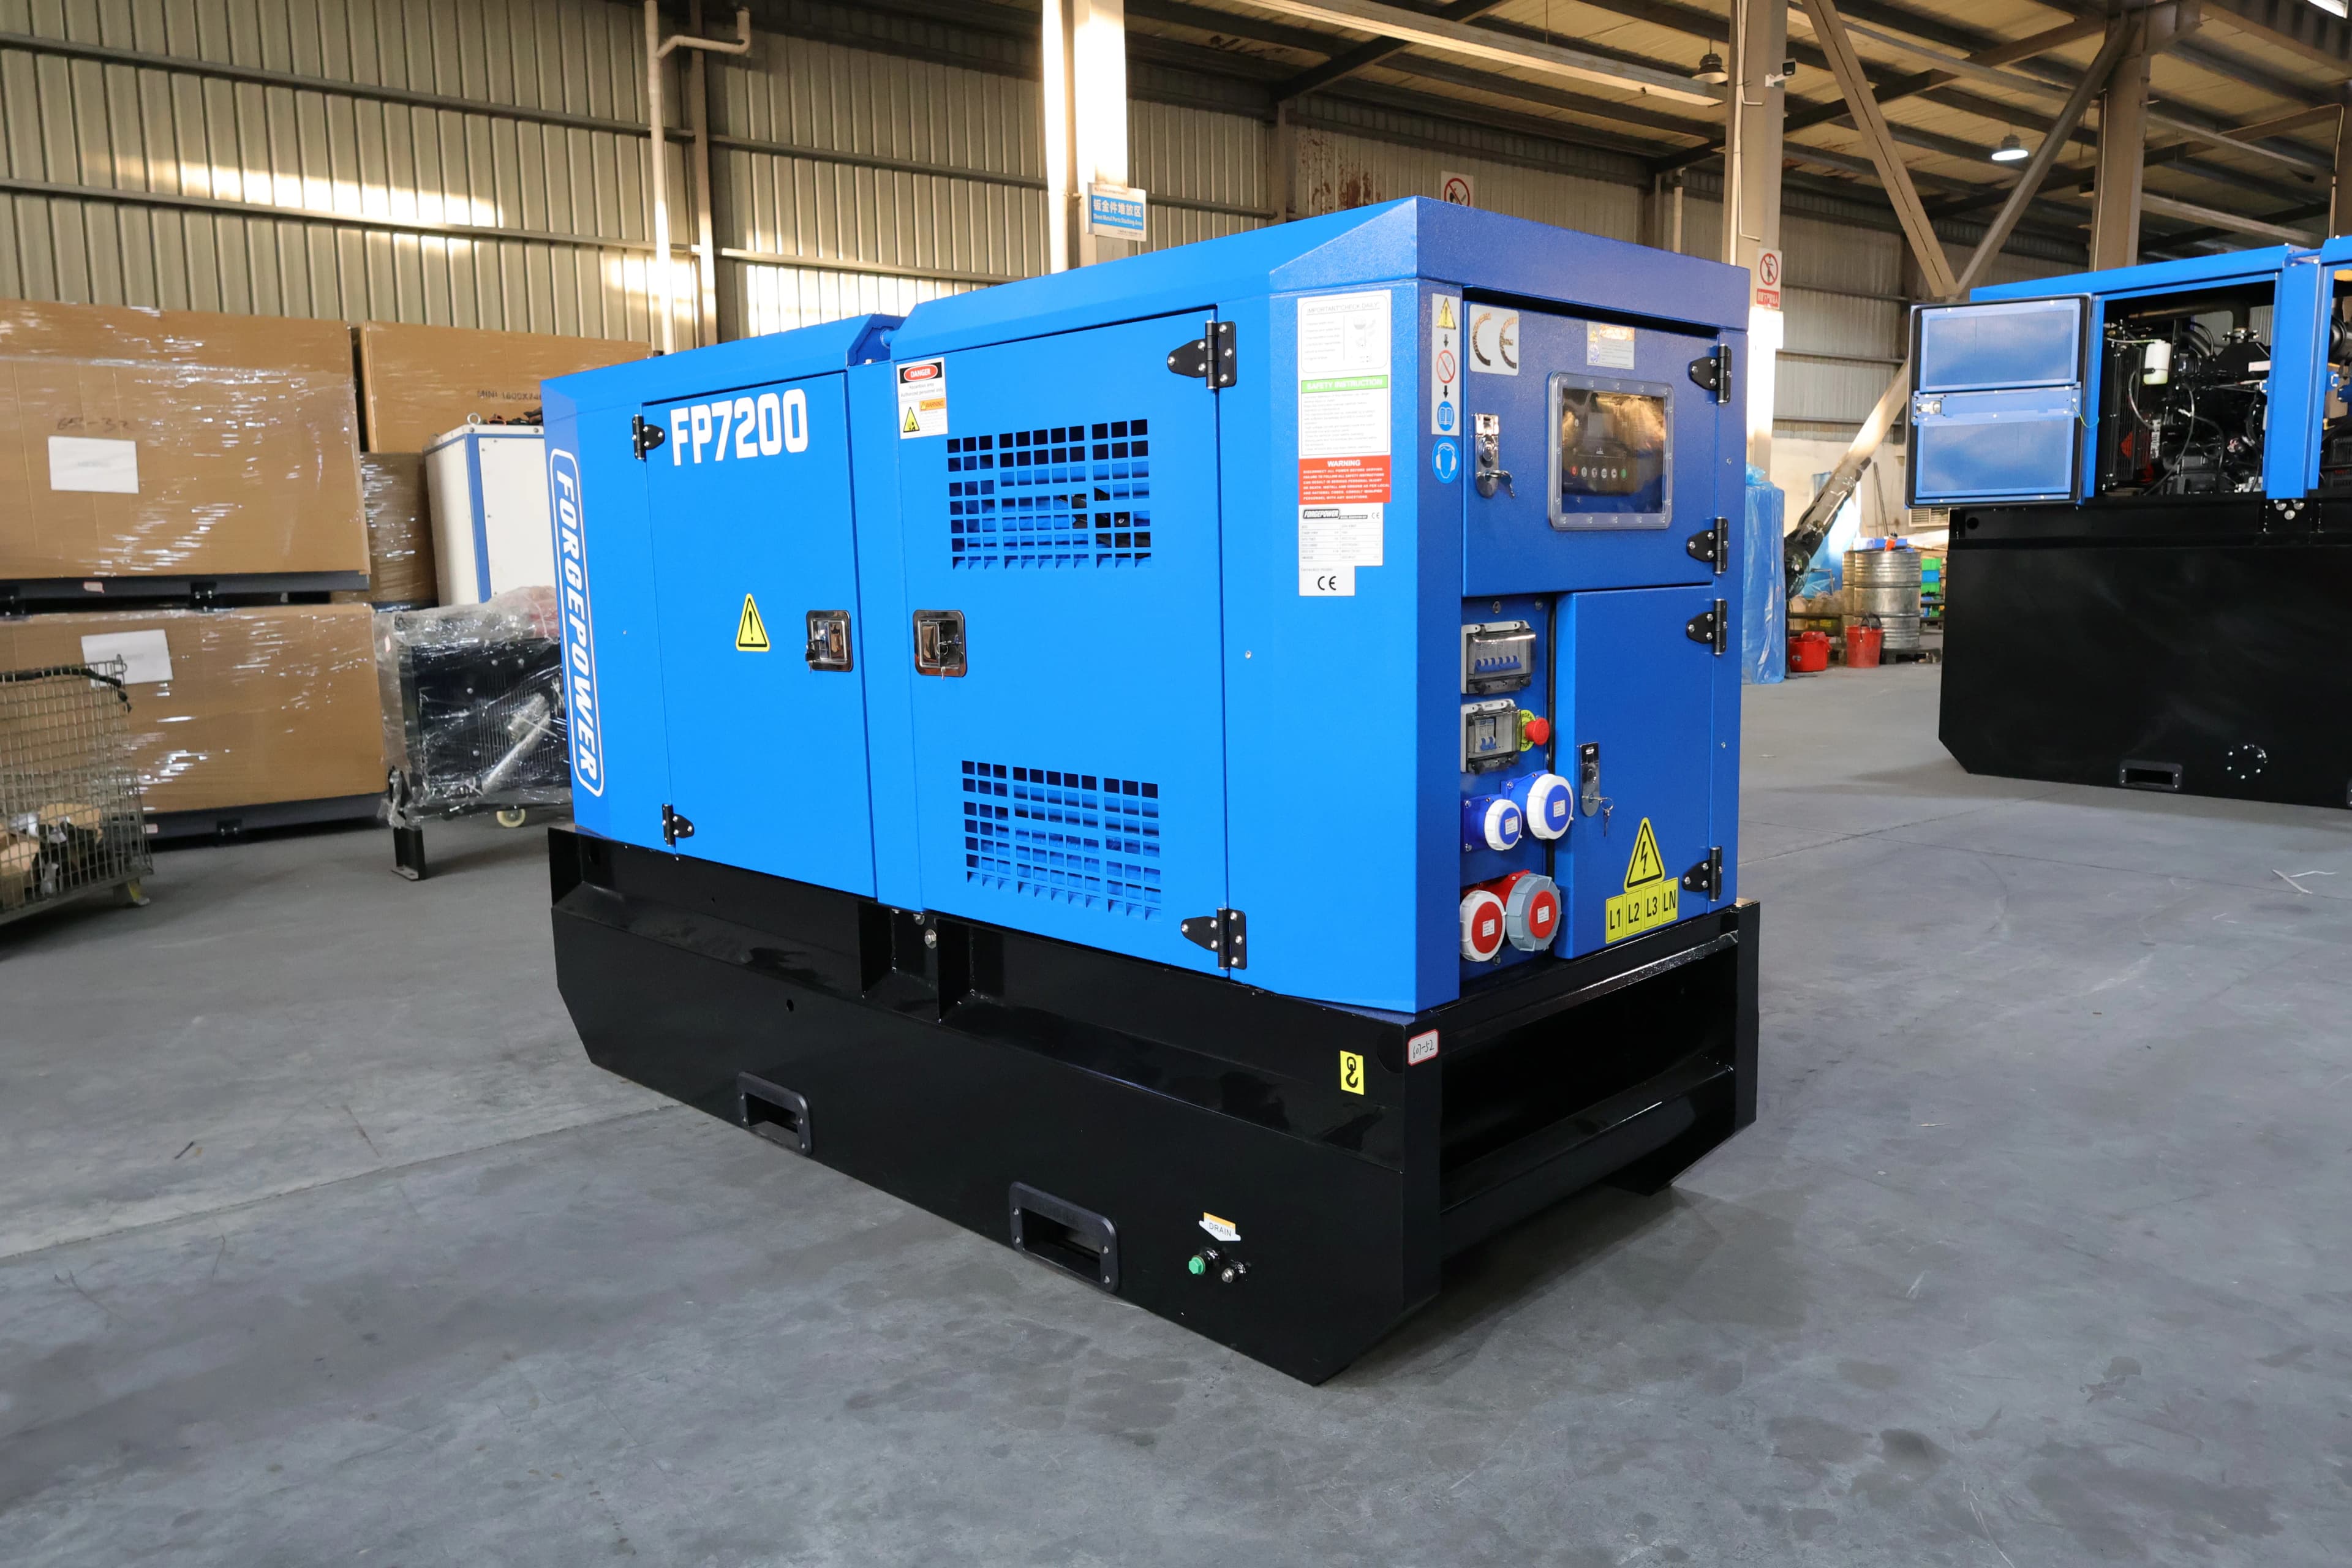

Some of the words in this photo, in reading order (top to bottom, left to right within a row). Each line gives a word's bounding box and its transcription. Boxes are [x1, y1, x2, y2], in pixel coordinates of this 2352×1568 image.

[910, 368, 931, 378] DANGER
[1335, 379, 1382, 388] INSTRUCTION
[670, 388, 809, 466] FP7200
[1304, 510, 1340, 519] FORGEPOWER
[1317, 576, 1336, 590] CE
[557, 470, 597, 780] FORGEPOWER
[1610, 908, 1621, 930] L1
[1628, 902, 1640, 924] L2
[1646, 896, 1657, 918] L3
[1664, 889, 1676, 911] LN
[1412, 1039, 1434, 1058] 607-52
[1209, 1223, 1231, 1237] DRAIN
